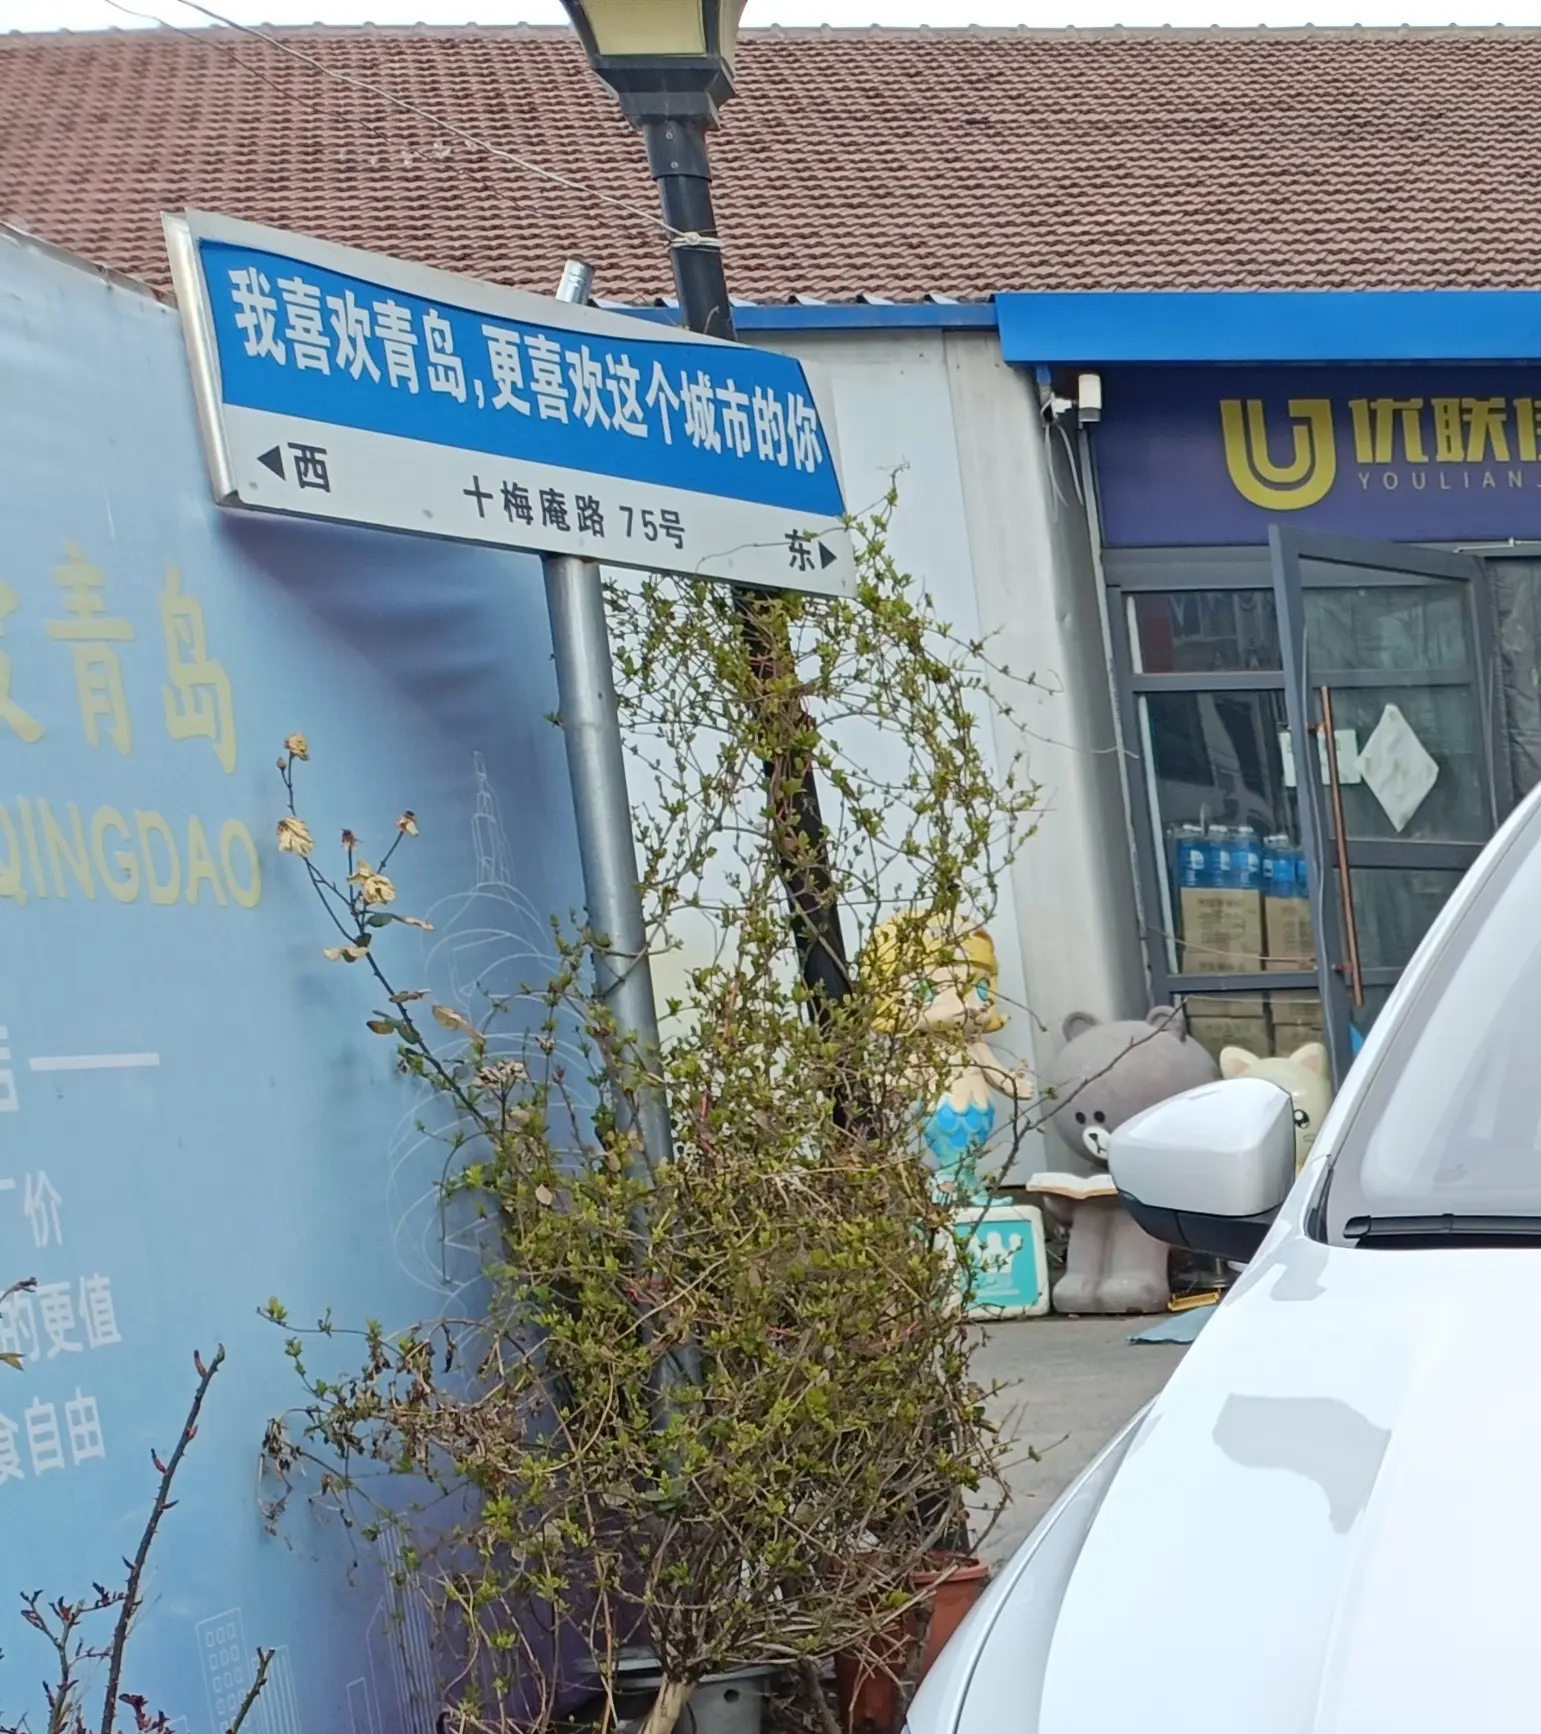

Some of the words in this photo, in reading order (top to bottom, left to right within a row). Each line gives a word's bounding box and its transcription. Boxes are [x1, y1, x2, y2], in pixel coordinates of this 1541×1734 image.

[228, 266, 823, 473] 我喜欢青岛,更喜欢这个城市的你
[287, 441, 332, 494] 西
[462, 475, 606, 539] 十梅庵路
[619, 504, 686, 551] 75号
[786, 529, 816, 572] 东
